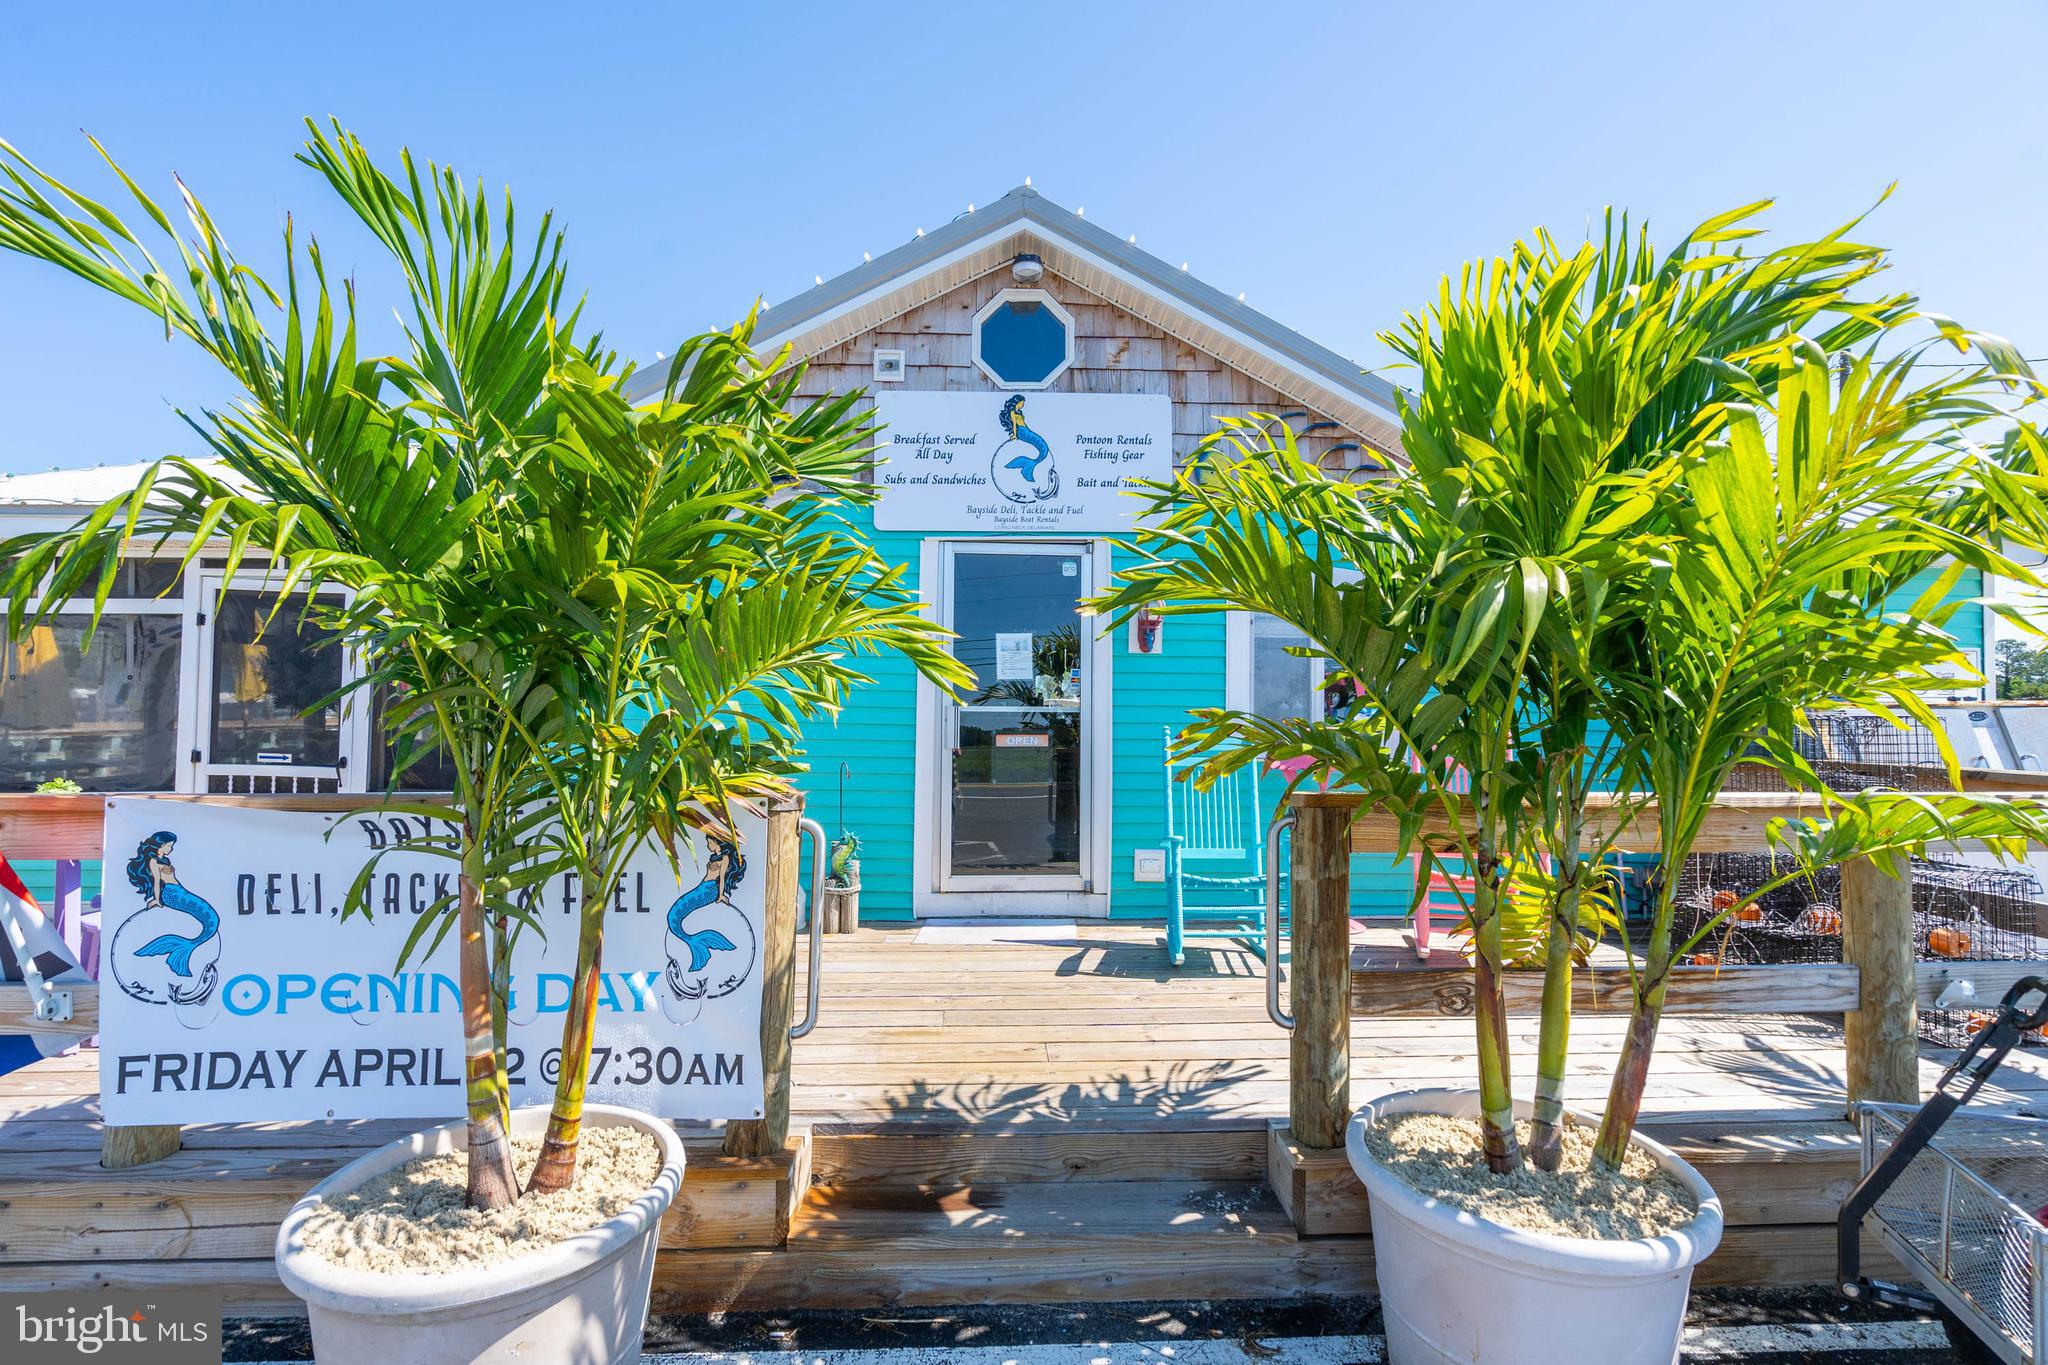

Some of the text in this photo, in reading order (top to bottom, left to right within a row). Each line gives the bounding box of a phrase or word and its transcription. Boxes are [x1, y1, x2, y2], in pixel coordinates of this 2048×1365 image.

[893, 432, 979, 449] Breakfast Served
[1075, 432, 1153, 446] Pontoon Rentals
[914, 447, 954, 465] All Day
[1083, 447, 1146, 464] Fishing Gear
[883, 471, 987, 485] Subs and Sandwiches
[1076, 477, 1098, 488] Bait
[1100, 475, 1121, 488] and
[966, 503, 1086, 520] Bayside Deli, Tackle and Fuel
[993, 515, 1018, 526] Bayside
[1036, 515, 1060, 524] Rentals
[1006, 736, 1038, 745] OPEN
[236, 873, 339, 918] DELI,
[562, 871, 650, 914] FEL
[222, 971, 662, 1016] OPENIN DAY
[116, 1049, 308, 1094] FRIDAY
[314, 1047, 461, 1088] APRIL
[588, 1046, 744, 1086] 7:30AM
